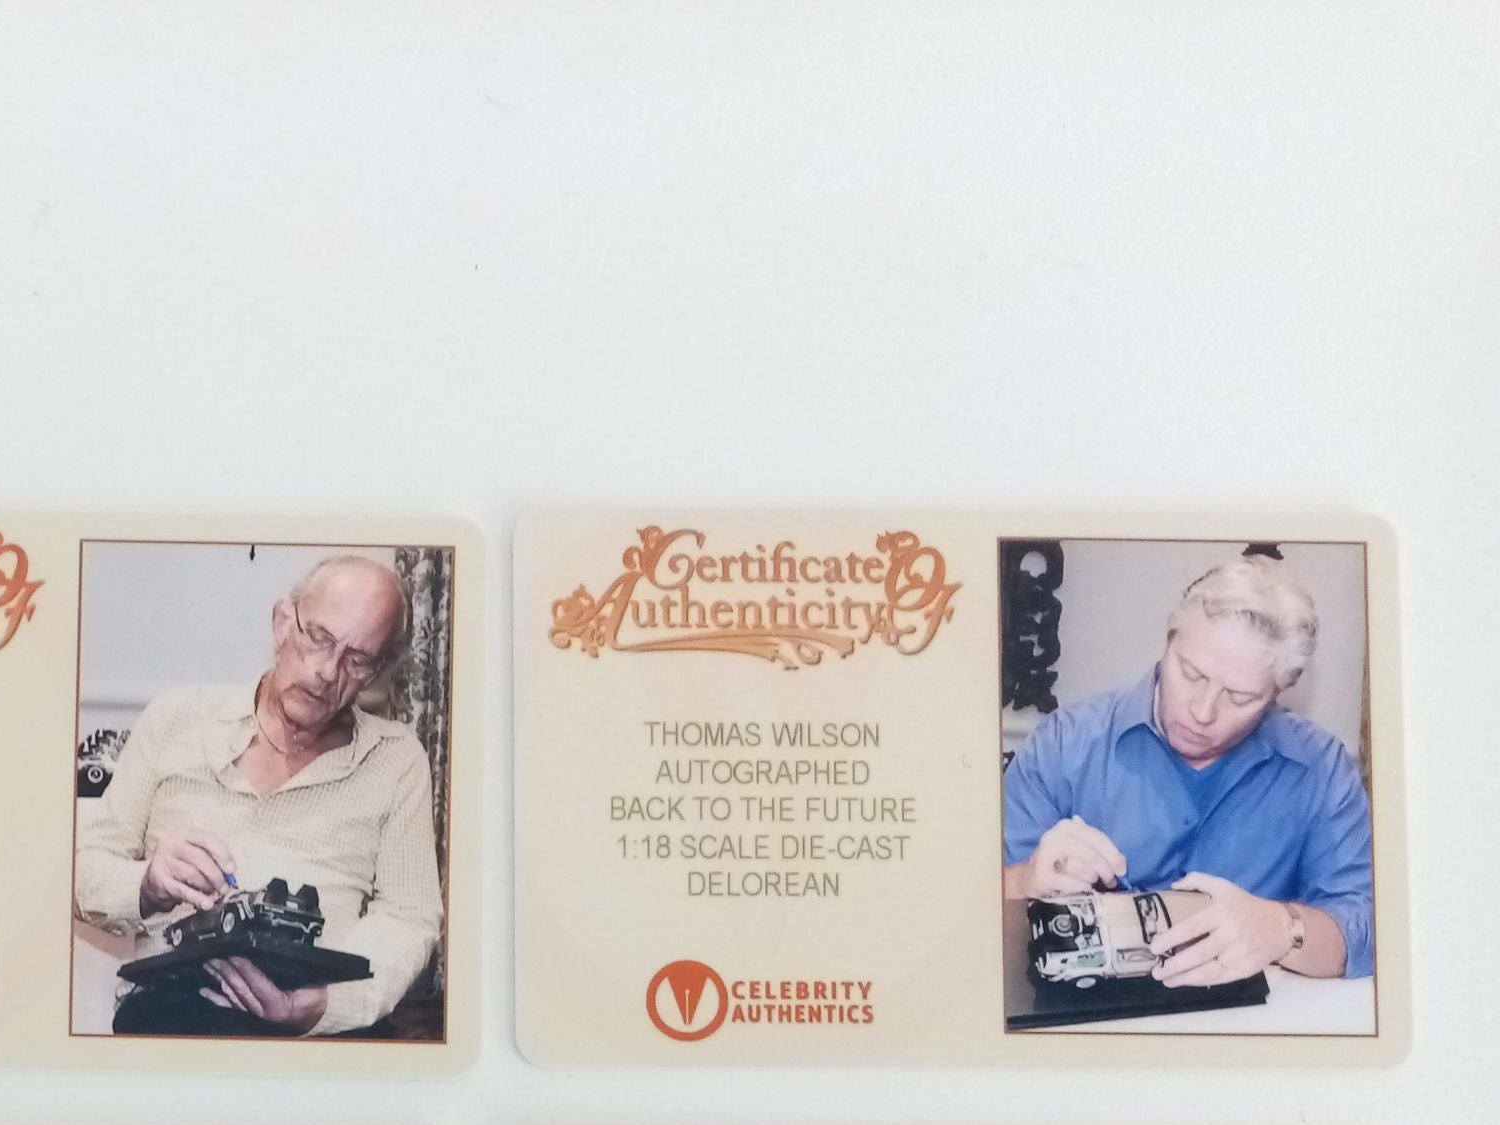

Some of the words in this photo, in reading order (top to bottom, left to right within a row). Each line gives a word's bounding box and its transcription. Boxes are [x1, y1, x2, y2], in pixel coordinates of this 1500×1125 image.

[623, 525, 885, 590] Certificate
[593, 571, 882, 651] Authenticity
[643, 720, 762, 748] THOMAS
[771, 722, 880, 748] WILSON
[655, 758, 871, 786] AUTOGRAPHED
[610, 795, 686, 822] BACK
[692, 795, 732, 822] TO
[739, 796, 795, 823] THE
[805, 796, 917, 823] FUTURE
[617, 833, 672, 860] 1:18
[679, 833, 770, 860] SCALE
[780, 834, 911, 861] DIE-CAST
[687, 870, 840, 898] DELOREAN
[730, 979, 873, 1002] CELEBRITY
[730, 1003, 875, 1025] AUTHENTICS
